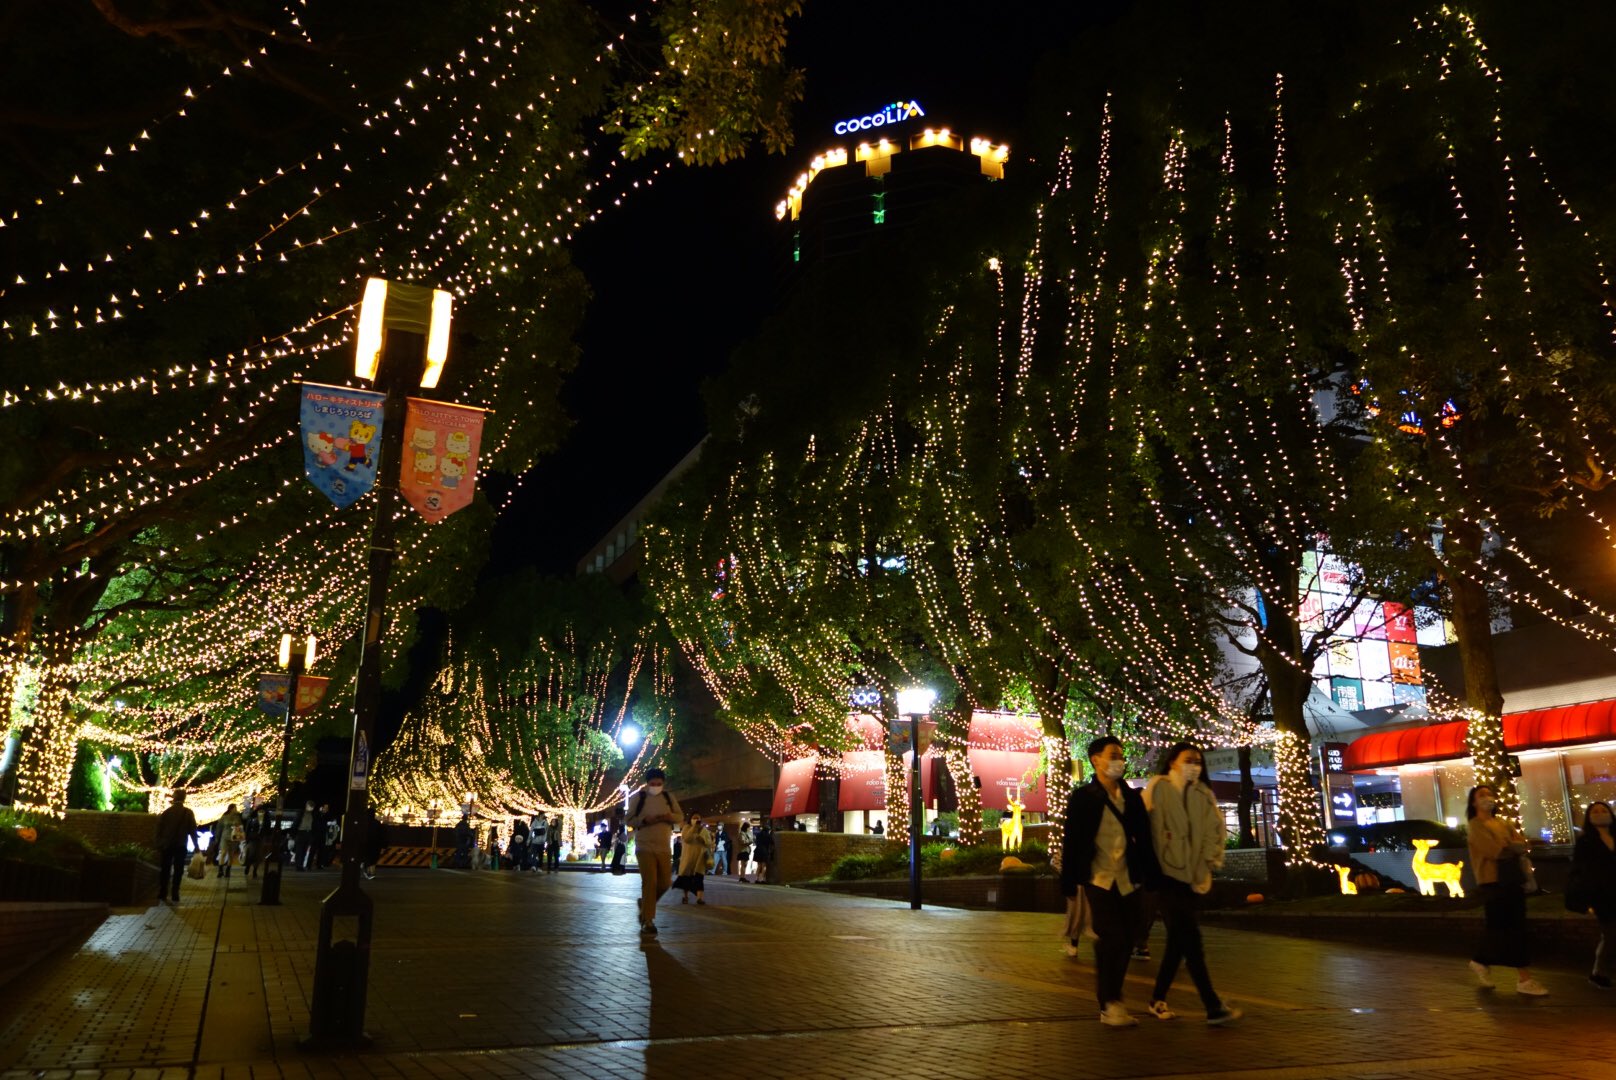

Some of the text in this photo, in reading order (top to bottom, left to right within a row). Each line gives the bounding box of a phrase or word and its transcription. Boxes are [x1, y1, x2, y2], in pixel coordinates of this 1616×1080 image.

[305, 392, 384, 409] ハローキティストリート
[314, 405, 373, 419] しまじろうひろば
[460, 415, 482, 425] TOWN
